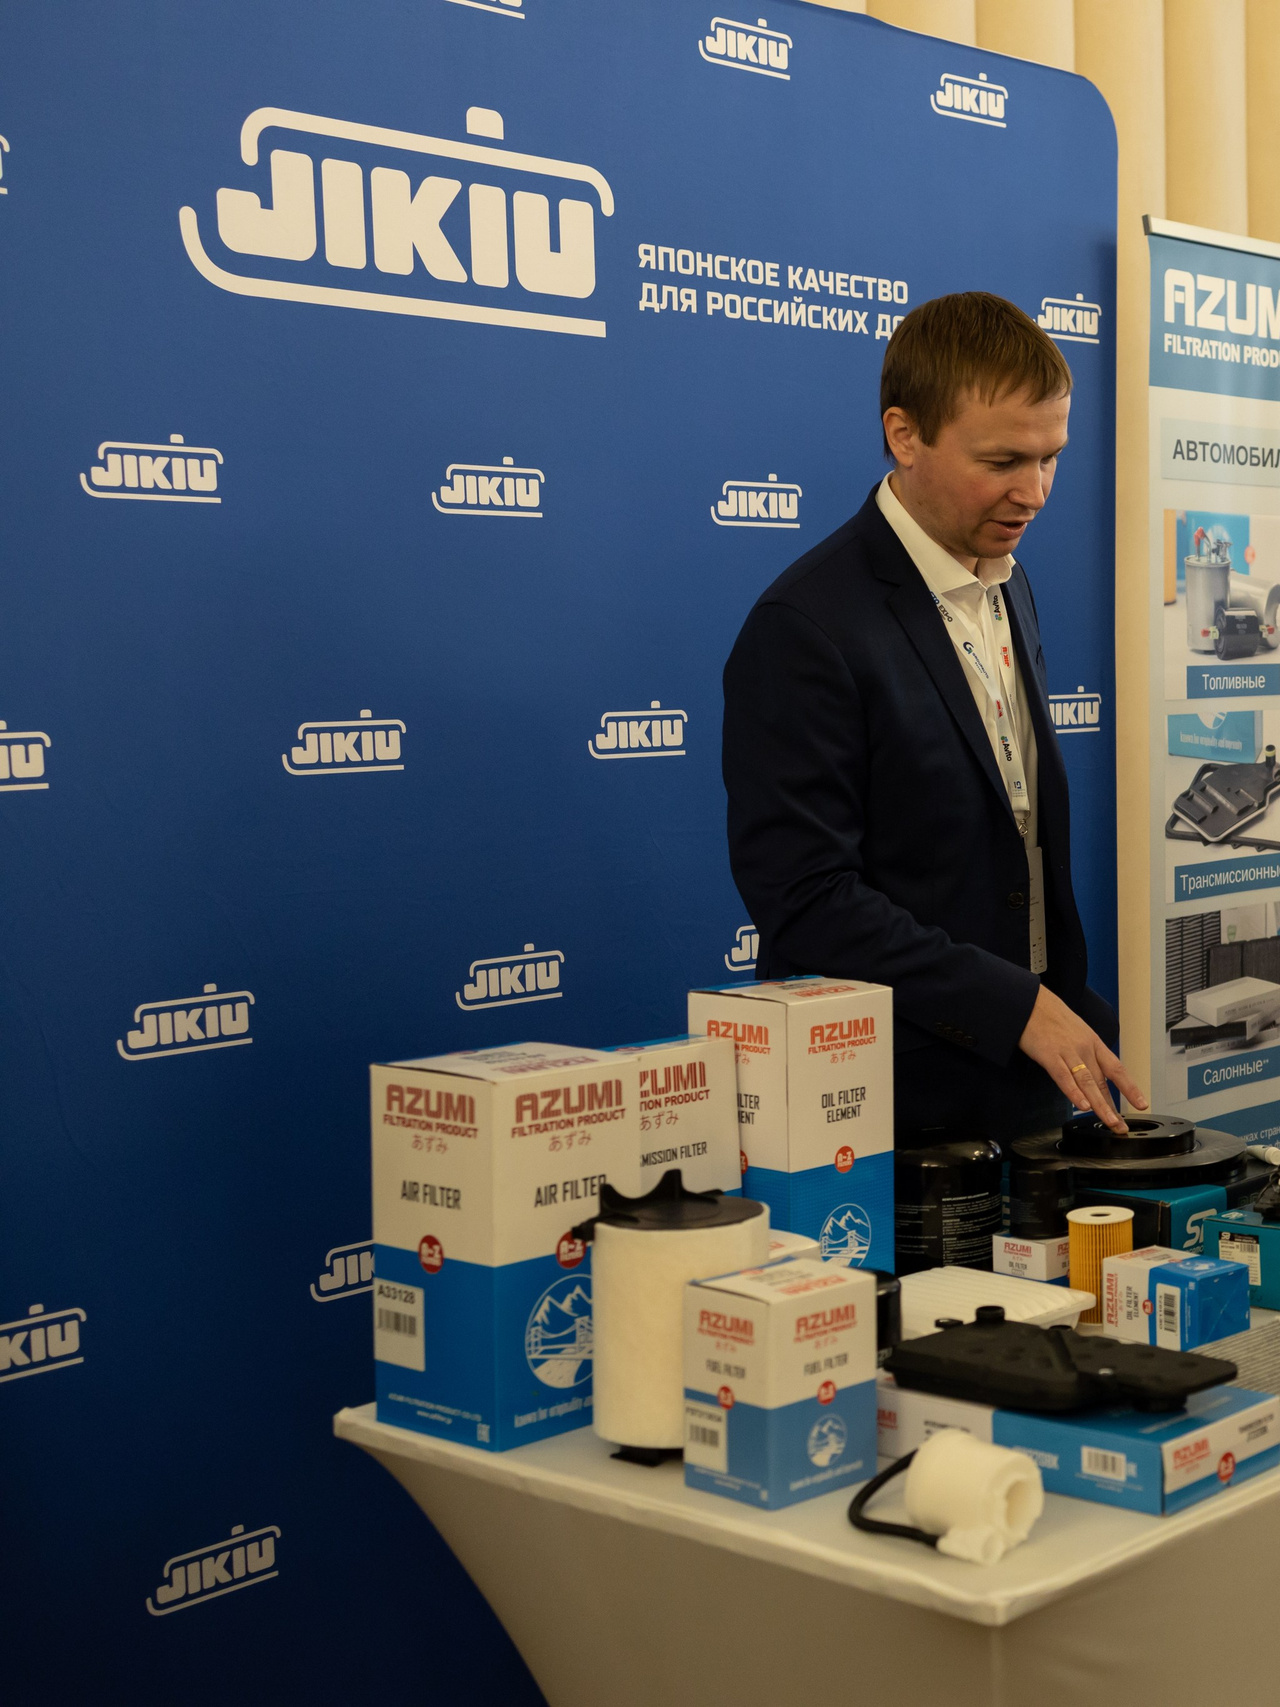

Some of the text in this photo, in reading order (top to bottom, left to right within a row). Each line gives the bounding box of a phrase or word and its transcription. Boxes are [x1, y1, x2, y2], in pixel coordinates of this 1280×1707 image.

[706, 28, 789, 70] JIKIU
[936, 75, 1004, 118] JIKIU
[216, 149, 596, 299] JIKIU
[638, 243, 908, 304] ЯПОНСКОЕ КАЧЕСТВО
[639, 282, 698, 314] ДЛЯ
[706, 291, 869, 335] РОССИЙСКИХ
[1038, 301, 1099, 335] JIKIU
[1164, 333, 1241, 364] FILTRATION
[90, 454, 217, 491] JIKIU
[440, 475, 540, 507] JIKIU
[717, 490, 798, 519] JIKIU
[1202, 673, 1266, 690] Топливные
[292, 730, 400, 765] JIKIU
[596, 719, 683, 749] JIKIU
[1003, 743, 1012, 761] Avito
[464, 960, 560, 1000] JIKIU
[127, 1003, 249, 1049] JIKIU
[707, 1020, 769, 1046] AZUMI
[810, 1017, 875, 1045] AZUMI
[741, 1043, 771, 1055] PRODUCT
[808, 1036, 876, 1055] FILTRATION PRODUCT
[830, 1050, 856, 1064] あずみ
[386, 1083, 475, 1124] AZUMI
[515, 1079, 622, 1124] AZUMI
[664, 1089, 711, 1108] PRODUCT
[738, 1093, 760, 1110] ILTER
[821, 1086, 866, 1109] OIL FILTER
[383, 1113, 479, 1139] FILTRATION PRODUCT
[511, 1108, 626, 1139] FILTRATION PRODUCT
[826, 1104, 861, 1123] ELEMENT
[412, 1134, 448, 1155] あずみ
[548, 1130, 592, 1152] あずみ
[1260, 1126, 1280, 1140] стран
[680, 1141, 707, 1160] FILTER
[401, 1180, 462, 1210] AIR FILTER
[534, 1183, 558, 1208] AIR
[1004, 1242, 1032, 1254] AZUMI
[1106, 1273, 1115, 1324] AZUMI
[700, 1309, 754, 1337] AZUMI
[796, 1303, 856, 1334] AZUMI
[0, 1320, 80, 1370] KIU
[157, 1536, 275, 1604] JIKIU
